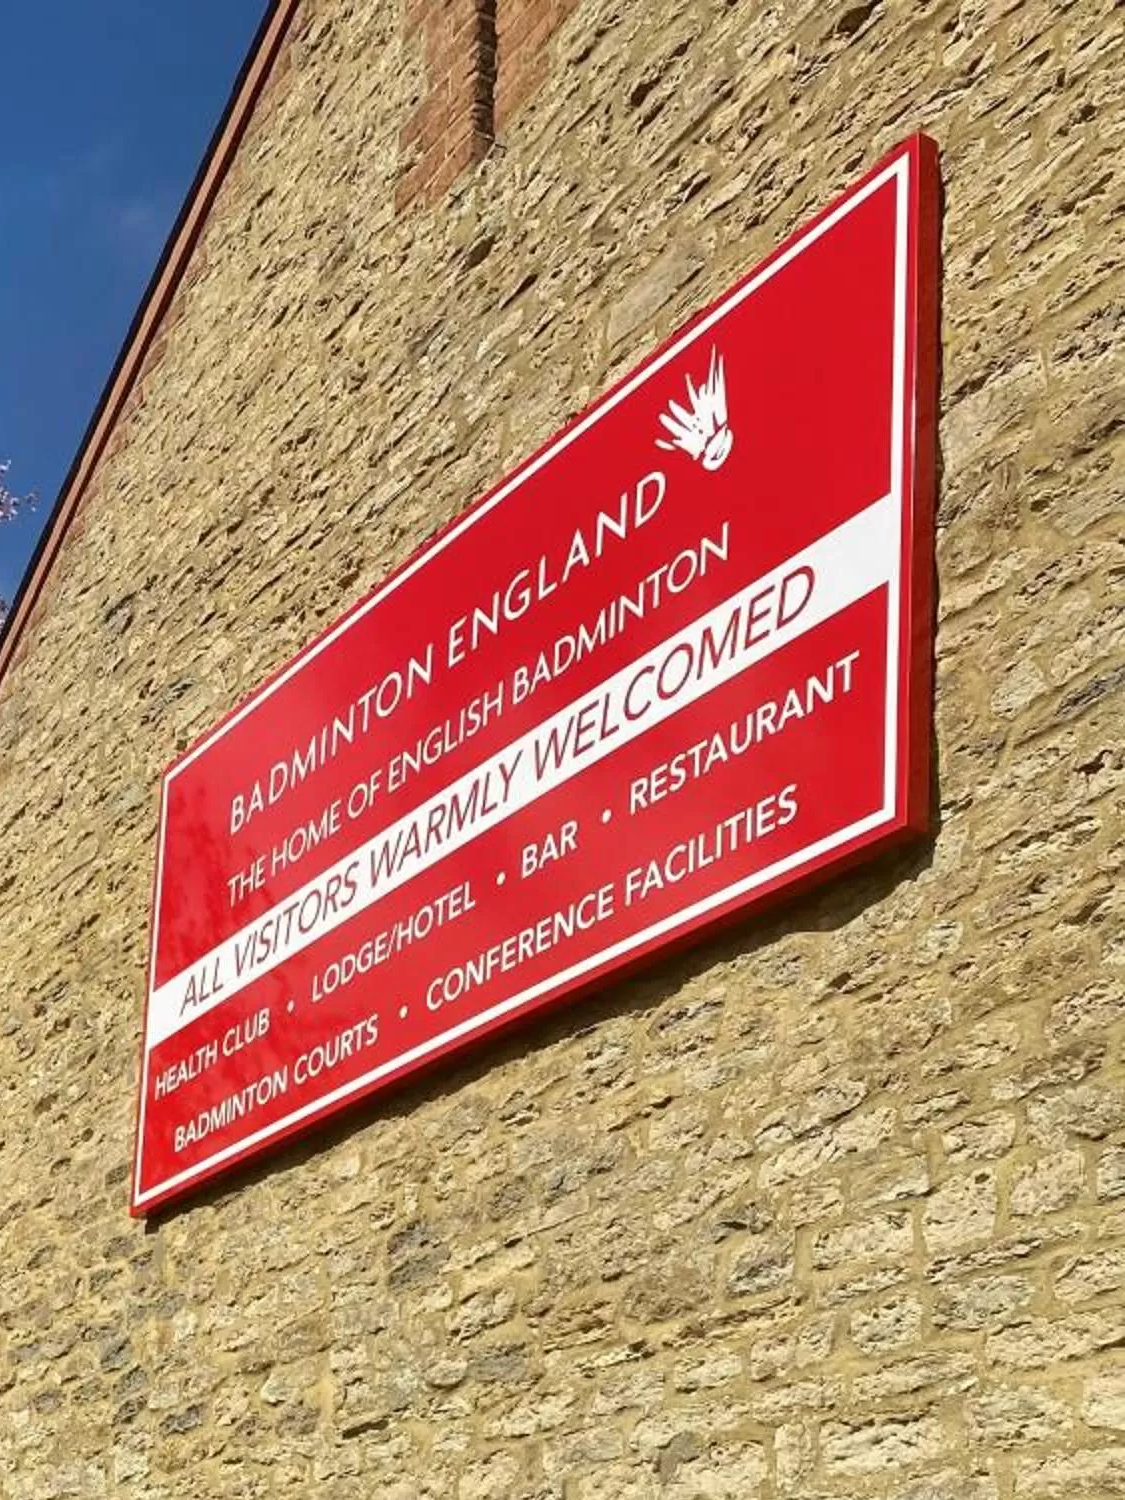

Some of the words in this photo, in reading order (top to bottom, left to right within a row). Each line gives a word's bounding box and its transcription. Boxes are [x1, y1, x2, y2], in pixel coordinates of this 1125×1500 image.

[180, 956, 224, 1015] ALL
[236, 860, 360, 977] VISITORS
[370, 748, 524, 886] WARMLY
[535, 566, 814, 780] WELCOMED
[228, 861, 266, 905] THE
[272, 800, 341, 867] HOME
[348, 770, 382, 820] OF
[388, 680, 504, 793] ENGLISH
[513, 523, 728, 704] BADMINTON
[231, 644, 432, 834] BADMINTON
[449, 472, 665, 667] ENGLAND
[155, 1042, 218, 1099] HEALTH
[223, 1008, 269, 1056] CLUB
[313, 882, 475, 1002] LODGE/HOTEL
[522, 821, 577, 878] BAR
[631, 651, 859, 814] RESTAURANT
[175, 1066, 287, 1152] BADMINTON
[294, 1014, 378, 1084] COURTS
[427, 884, 613, 1010] CONFERENCE
[625, 784, 797, 906] FACILITIES
